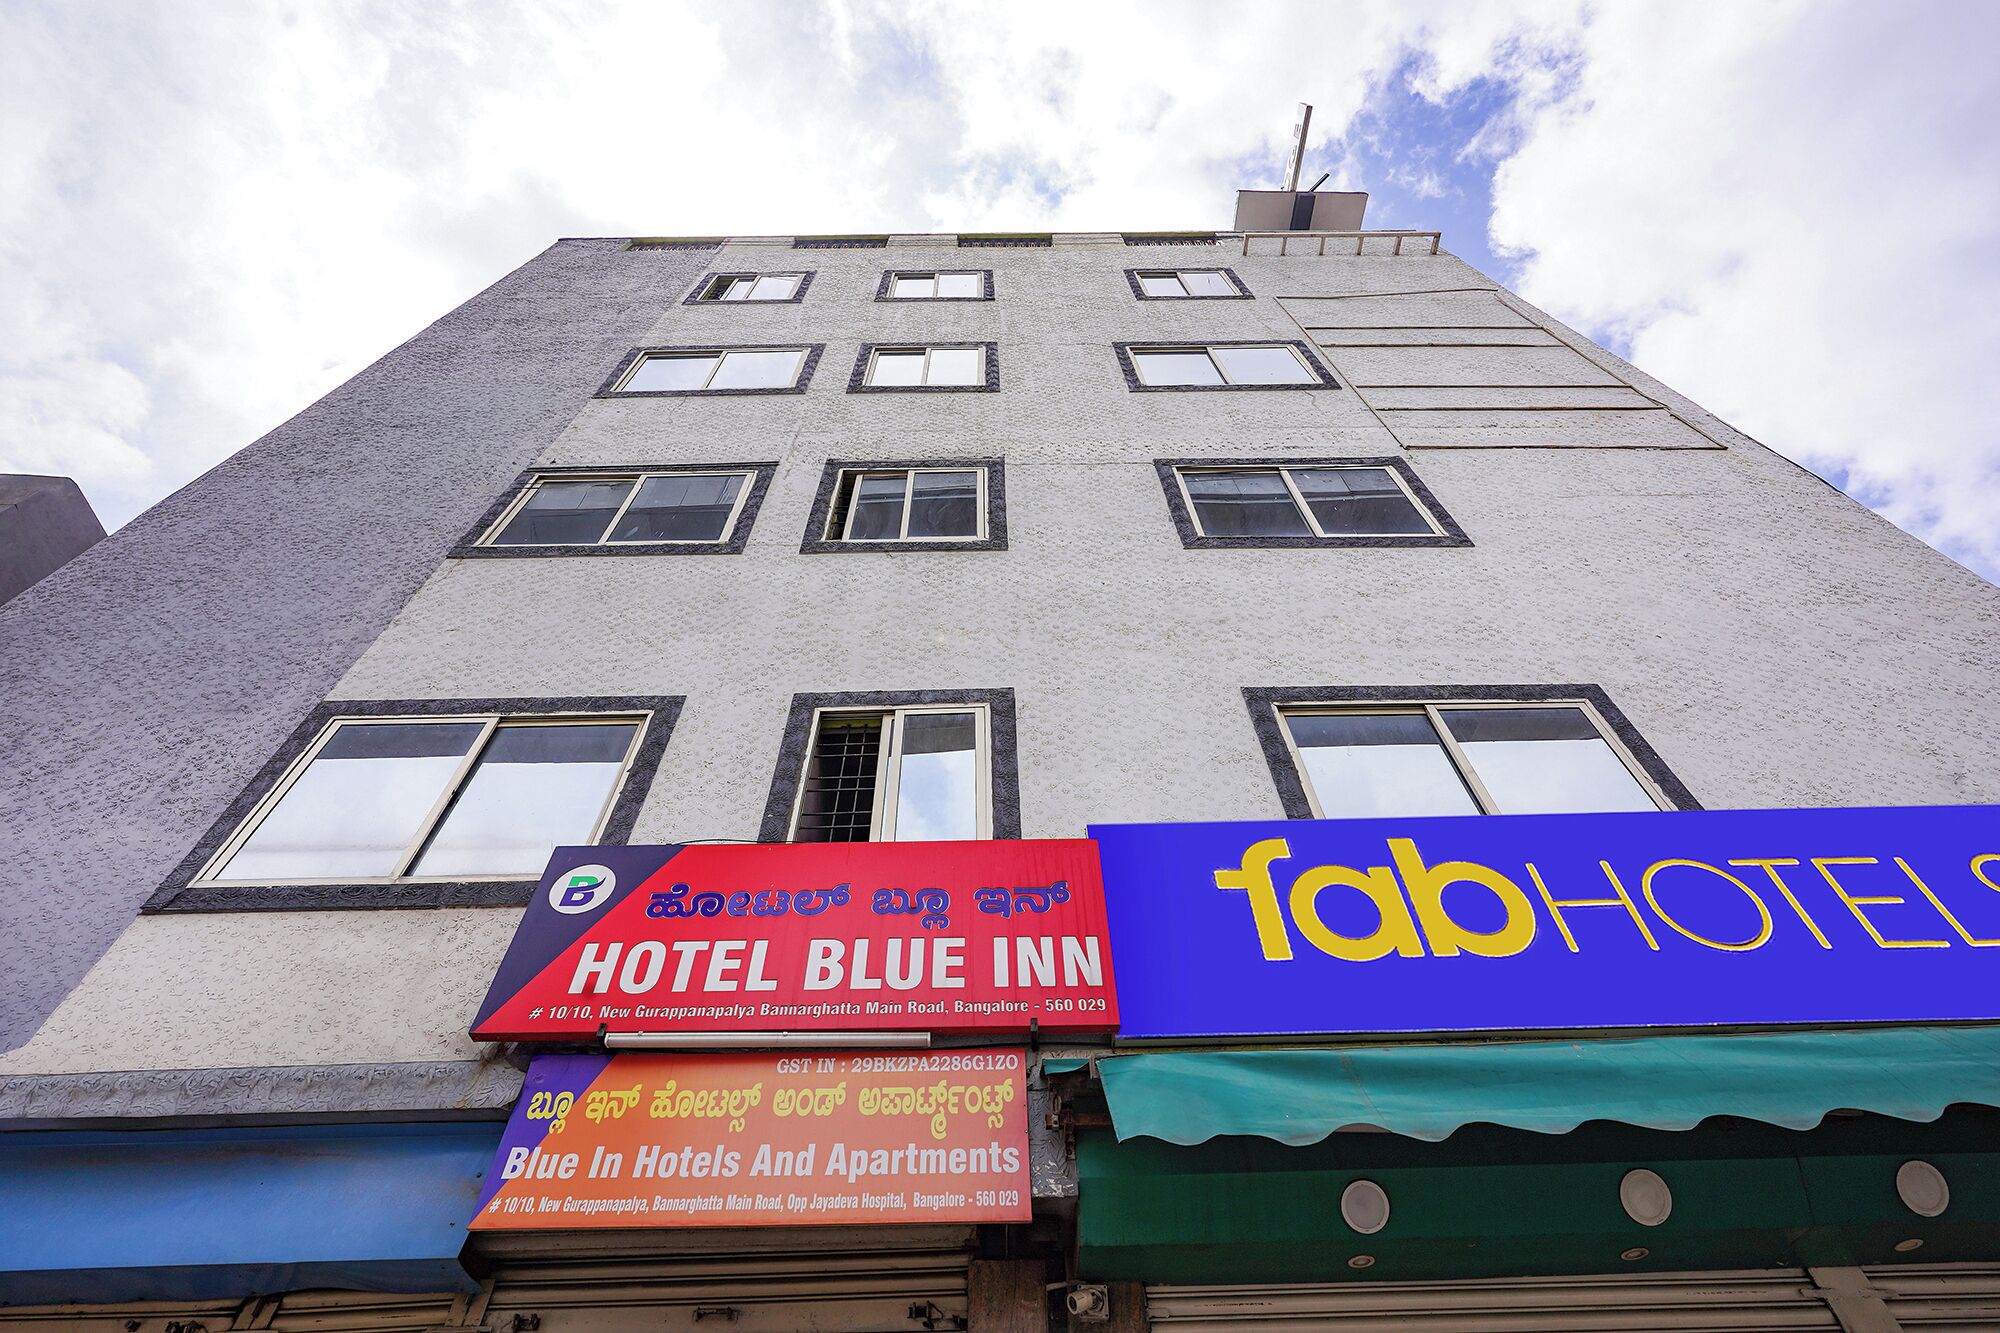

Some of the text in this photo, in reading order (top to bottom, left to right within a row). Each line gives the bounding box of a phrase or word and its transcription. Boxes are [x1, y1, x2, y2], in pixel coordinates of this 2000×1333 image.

[973, 880, 1071, 919] ಇನ್
[567, 936, 1104, 995] HOTEL BLUE INN
[548, 1005, 594, 1021] 10/10,
[599, 1004, 631, 1018] New
[634, 1002, 755, 1023] Gurappanapalya
[760, 1001, 861, 1018] Bannarghatta
[865, 1001, 903, 1015] Main
[907, 1000, 949, 1015] Road,
[954, 999, 1029, 1016] Bangalore
[1045, 998, 1073, 1011] 560
[1078, 998, 1106, 1011] 029
[776, 1057, 812, 1074] GST
[816, 1057, 836, 1073] IN
[585, 1083, 643, 1124] ಇನ್
[500, 1141, 1021, 1183] Blue In Hotels And Apartments
[502, 1195, 536, 1215] 10/10,
[537, 1196, 561, 1213] New
[562, 1194, 650, 1216] Gurappanapalya,
[652, 1195, 724, 1214] Bannarghatta
[725, 1194, 752, 1211] Main
[754, 1193, 785, 1212] Road,
[787, 1193, 808, 1213] Opp
[809, 1193, 859, 1211] Jayadeva
[861, 1192, 908, 1212] Hospital,
[912, 1191, 966, 1210] Bangalore
[976, 1190, 997, 1207] 560
[999, 1190, 1019, 1206] 029
